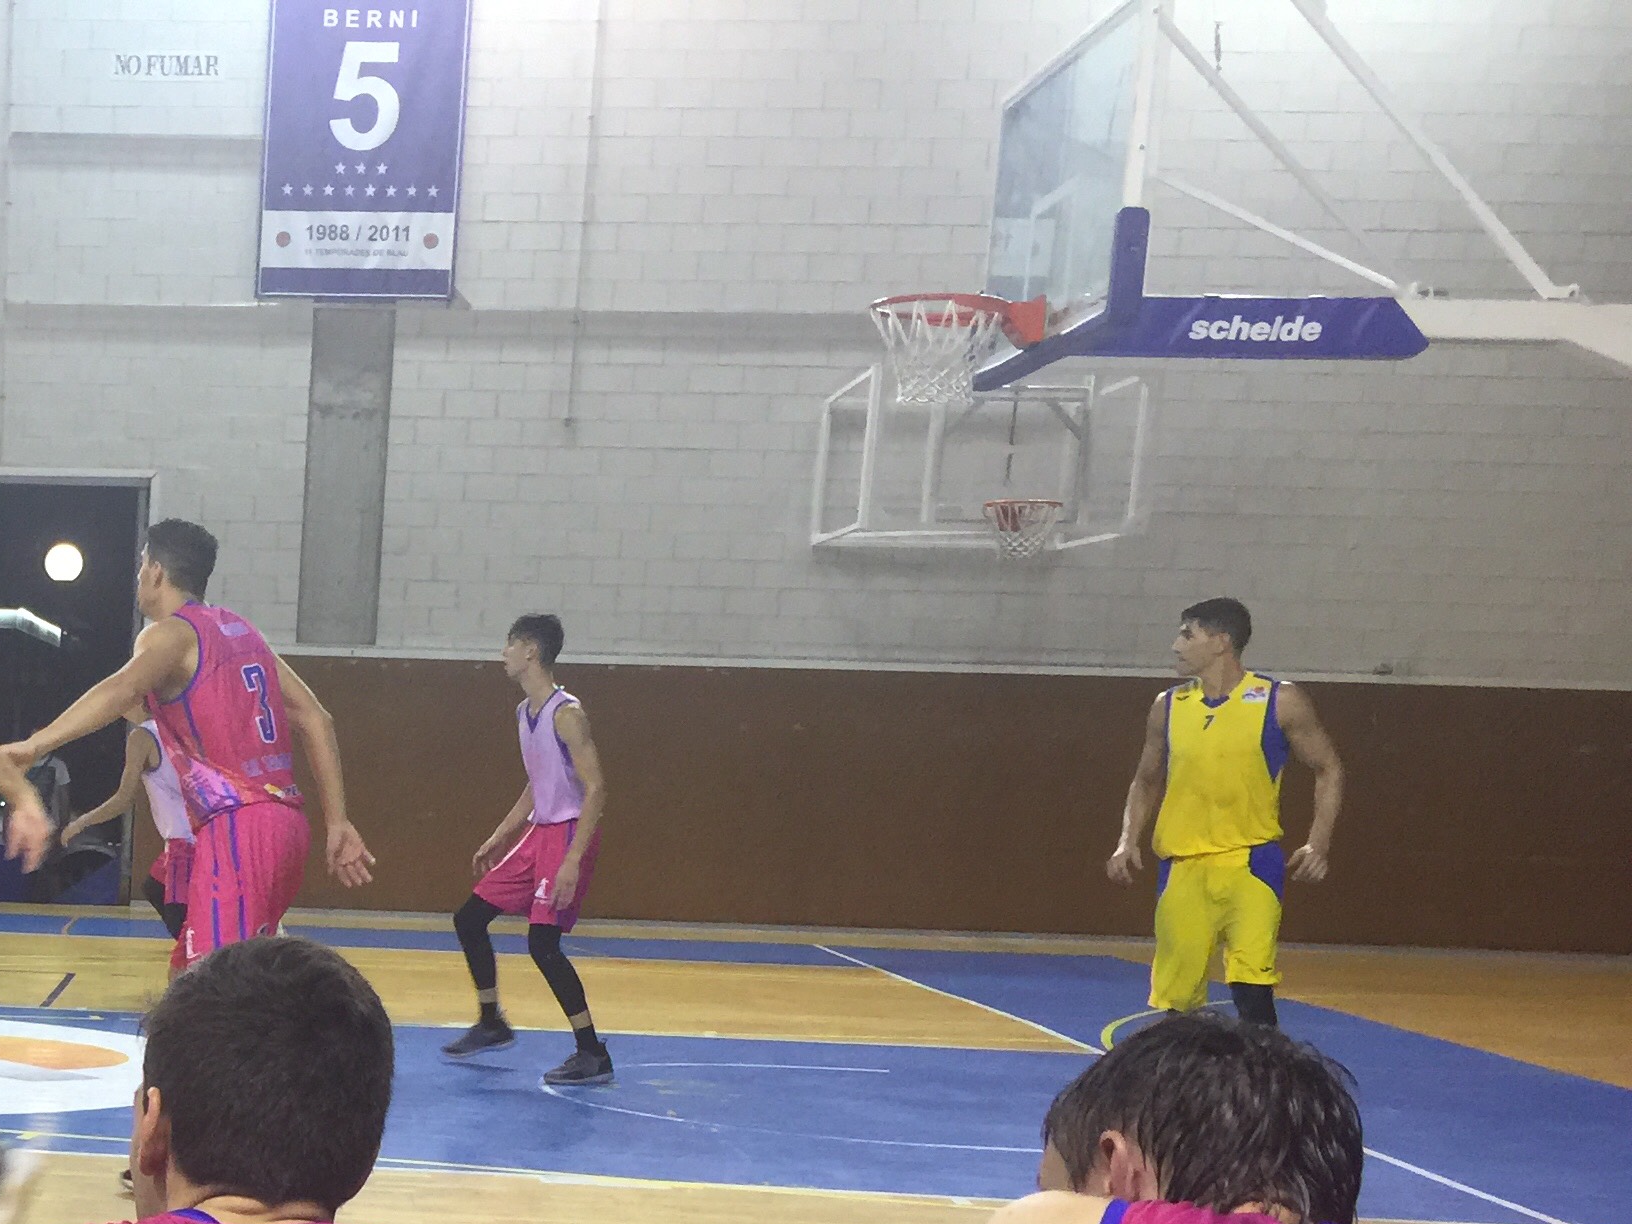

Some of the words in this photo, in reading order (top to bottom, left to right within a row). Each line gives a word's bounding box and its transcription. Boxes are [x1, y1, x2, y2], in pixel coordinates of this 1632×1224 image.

[323, 9, 418, 28] BERNI
[114, 54, 142, 76] NO
[145, 54, 219, 76] FUMAR
[329, 41, 400, 151] 5
[306, 224, 350, 241] 1988
[368, 225, 411, 241] 2011
[1188, 315, 1323, 342] schelde
[241, 662, 277, 743] 3
[1202, 715, 1215, 730] 7
